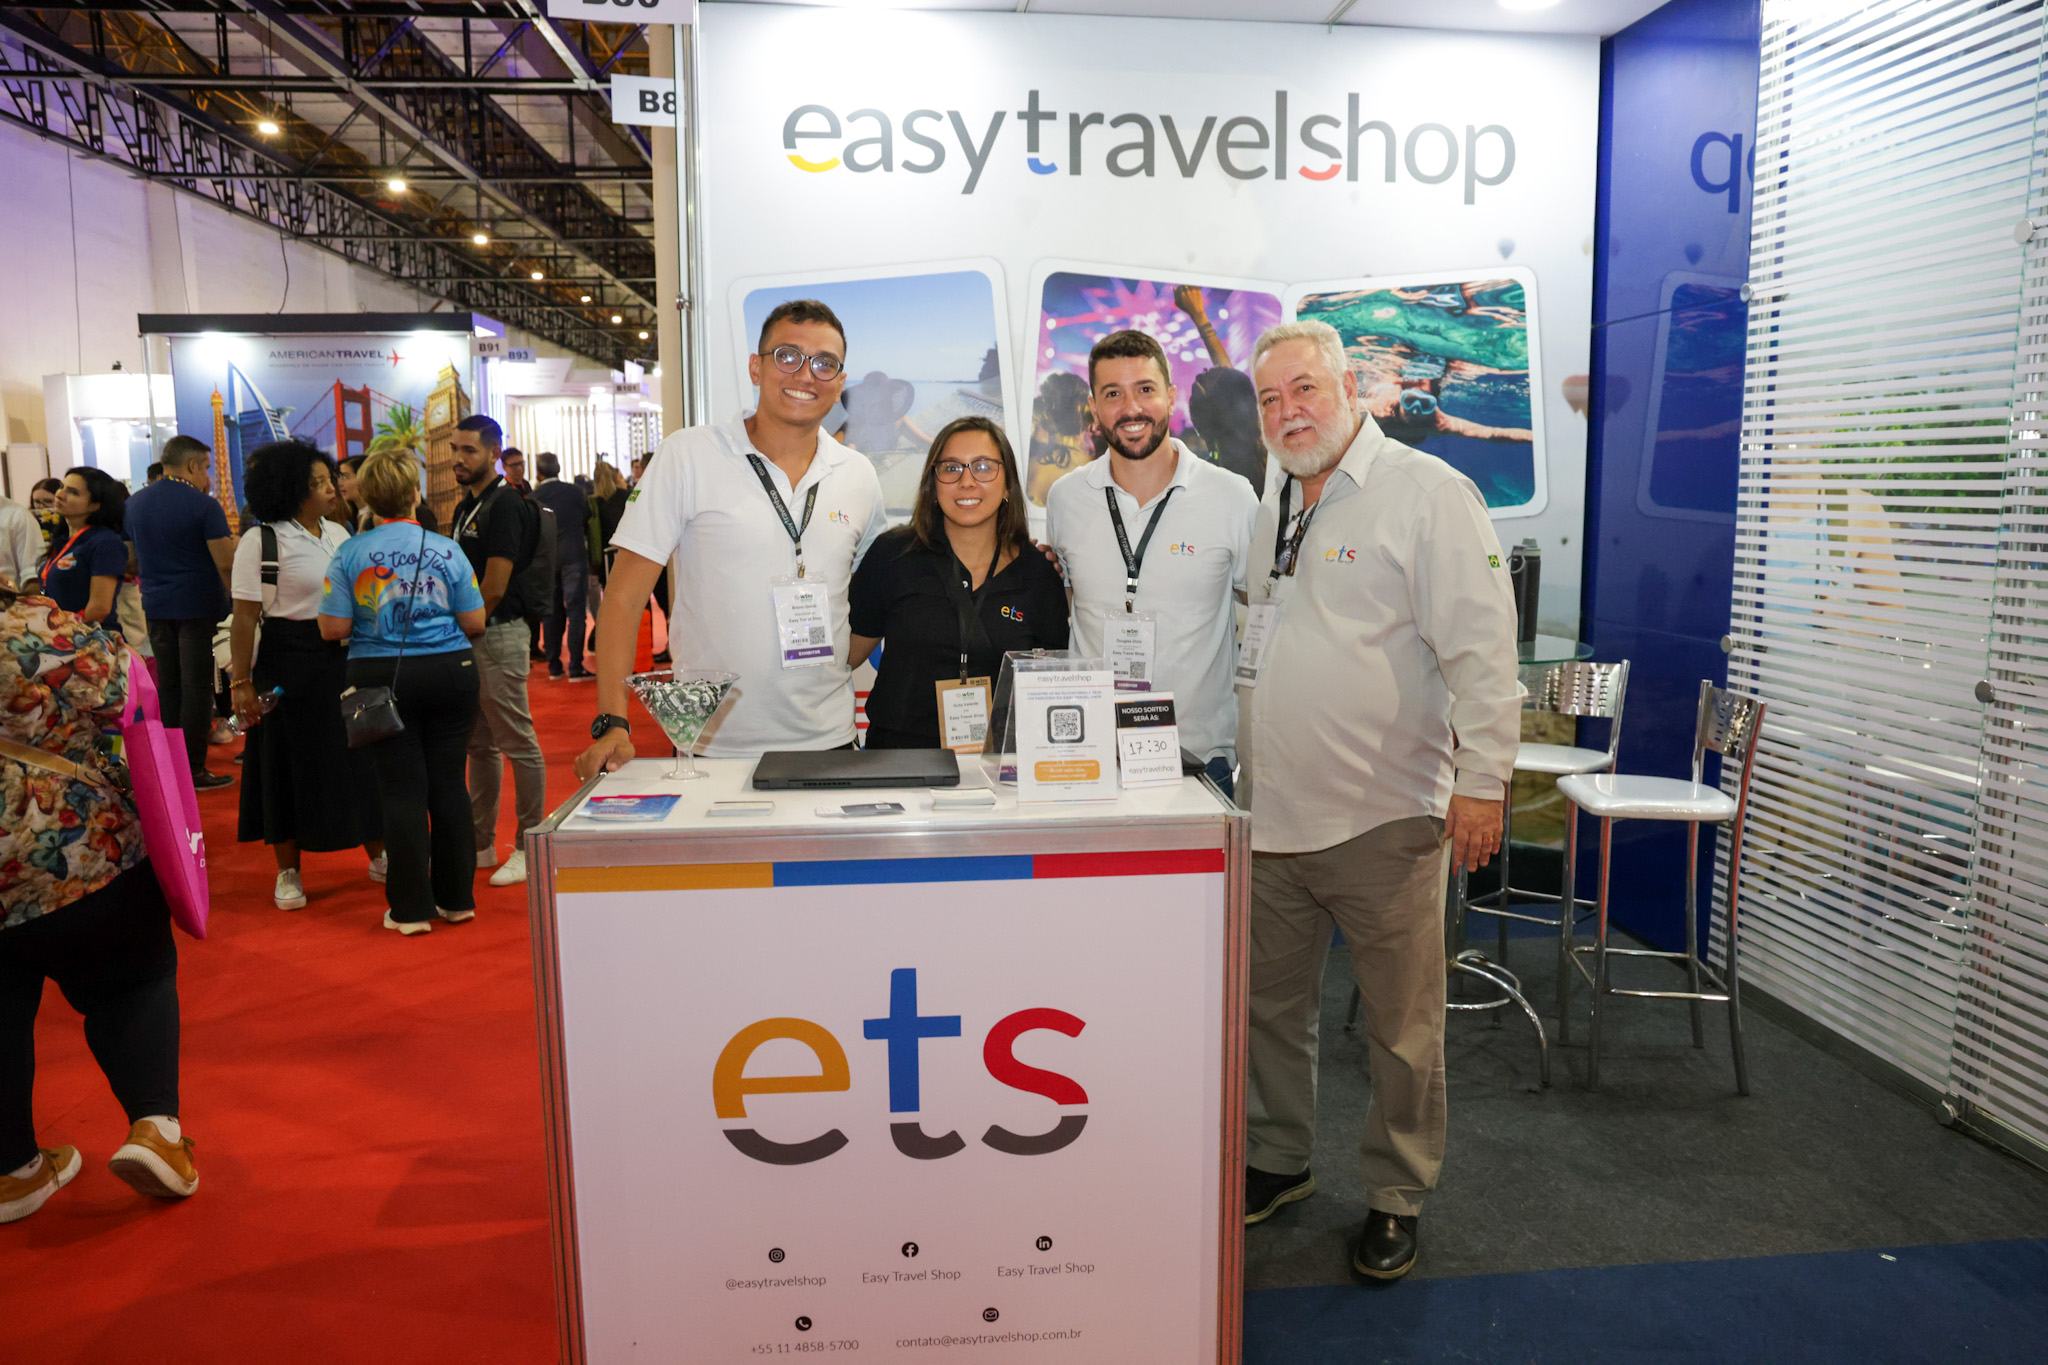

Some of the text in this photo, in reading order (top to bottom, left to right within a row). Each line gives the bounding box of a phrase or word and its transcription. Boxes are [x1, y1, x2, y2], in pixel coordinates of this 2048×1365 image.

[782, 89, 1517, 205] easytravelshop
[479, 342, 500, 352] B91
[269, 350, 385, 360] AMERICANTRAVEL
[508, 350, 529, 360] B93
[829, 509, 850, 526] ets
[1169, 541, 1196, 557] ets
[1325, 545, 1357, 564] ets
[1001, 605, 1024, 622] ets
[1133, 714, 1150, 722] SERÁ
[1128, 764, 1176, 774] easytravelshop
[712, 967, 1089, 1166] ets
[862, 1269, 961, 1284] Easy Travel Shop
[997, 1262, 1095, 1278] Easy Travel Shop
[725, 1276, 827, 1290] @easytravelshop
[896, 1328, 1082, 1349] contato@easytravelshop.com.br
[752, 1339, 859, 1354] +55 11 4858-5700
